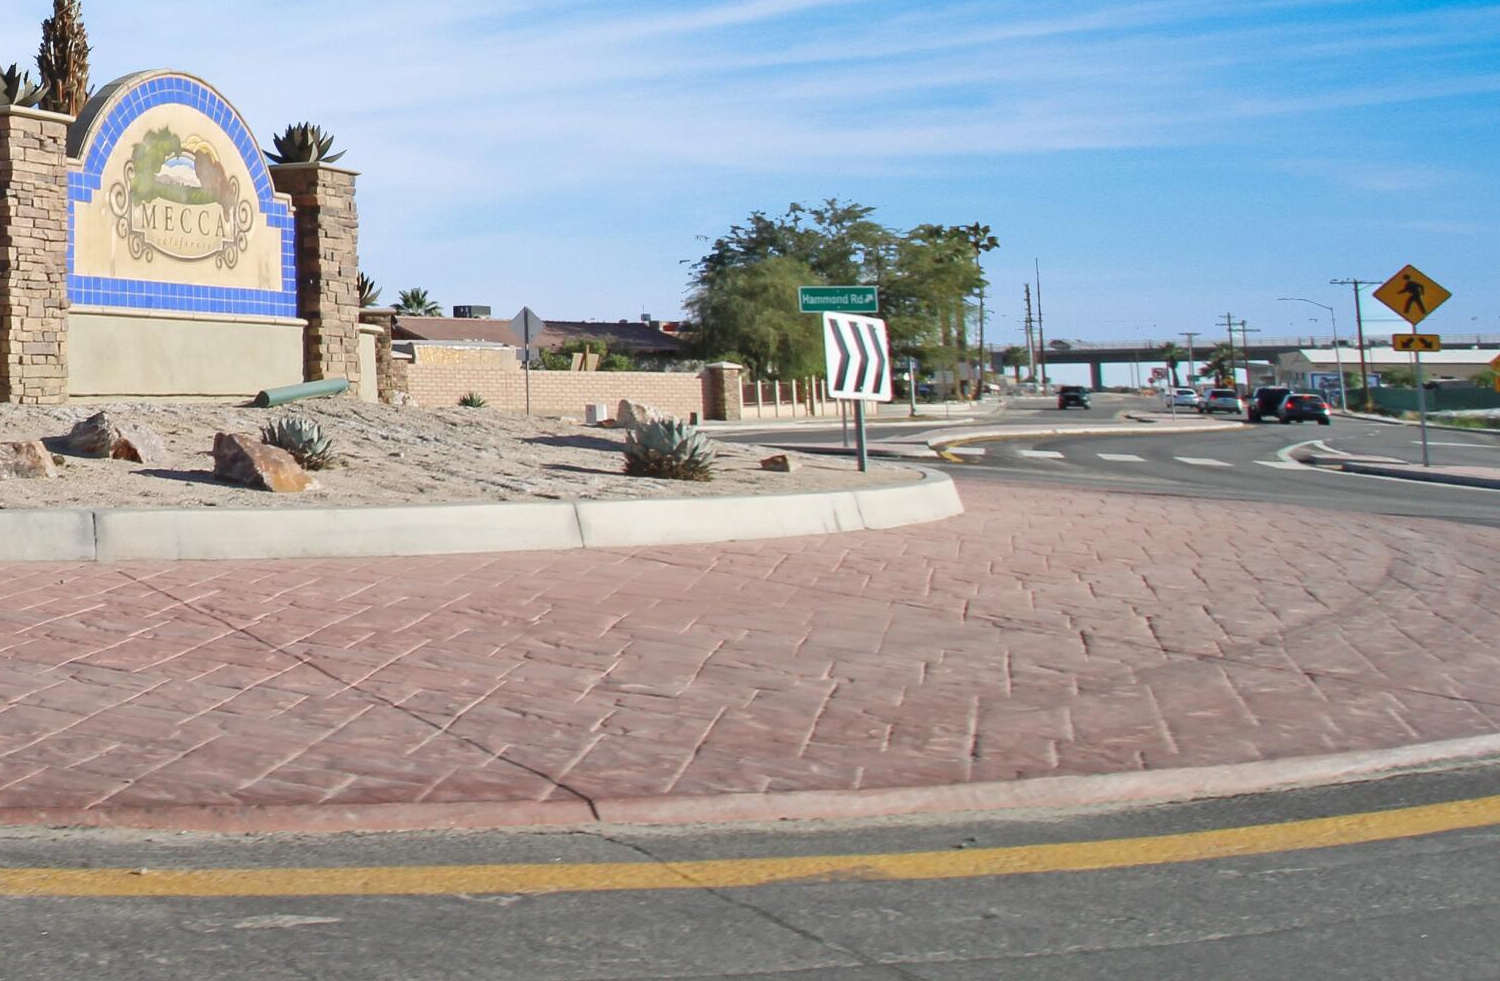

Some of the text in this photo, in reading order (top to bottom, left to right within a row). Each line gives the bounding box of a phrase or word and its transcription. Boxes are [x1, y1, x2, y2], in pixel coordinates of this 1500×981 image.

[142, 204, 226, 237] MECCA
[802, 294, 864, 304] Hammond Rd
